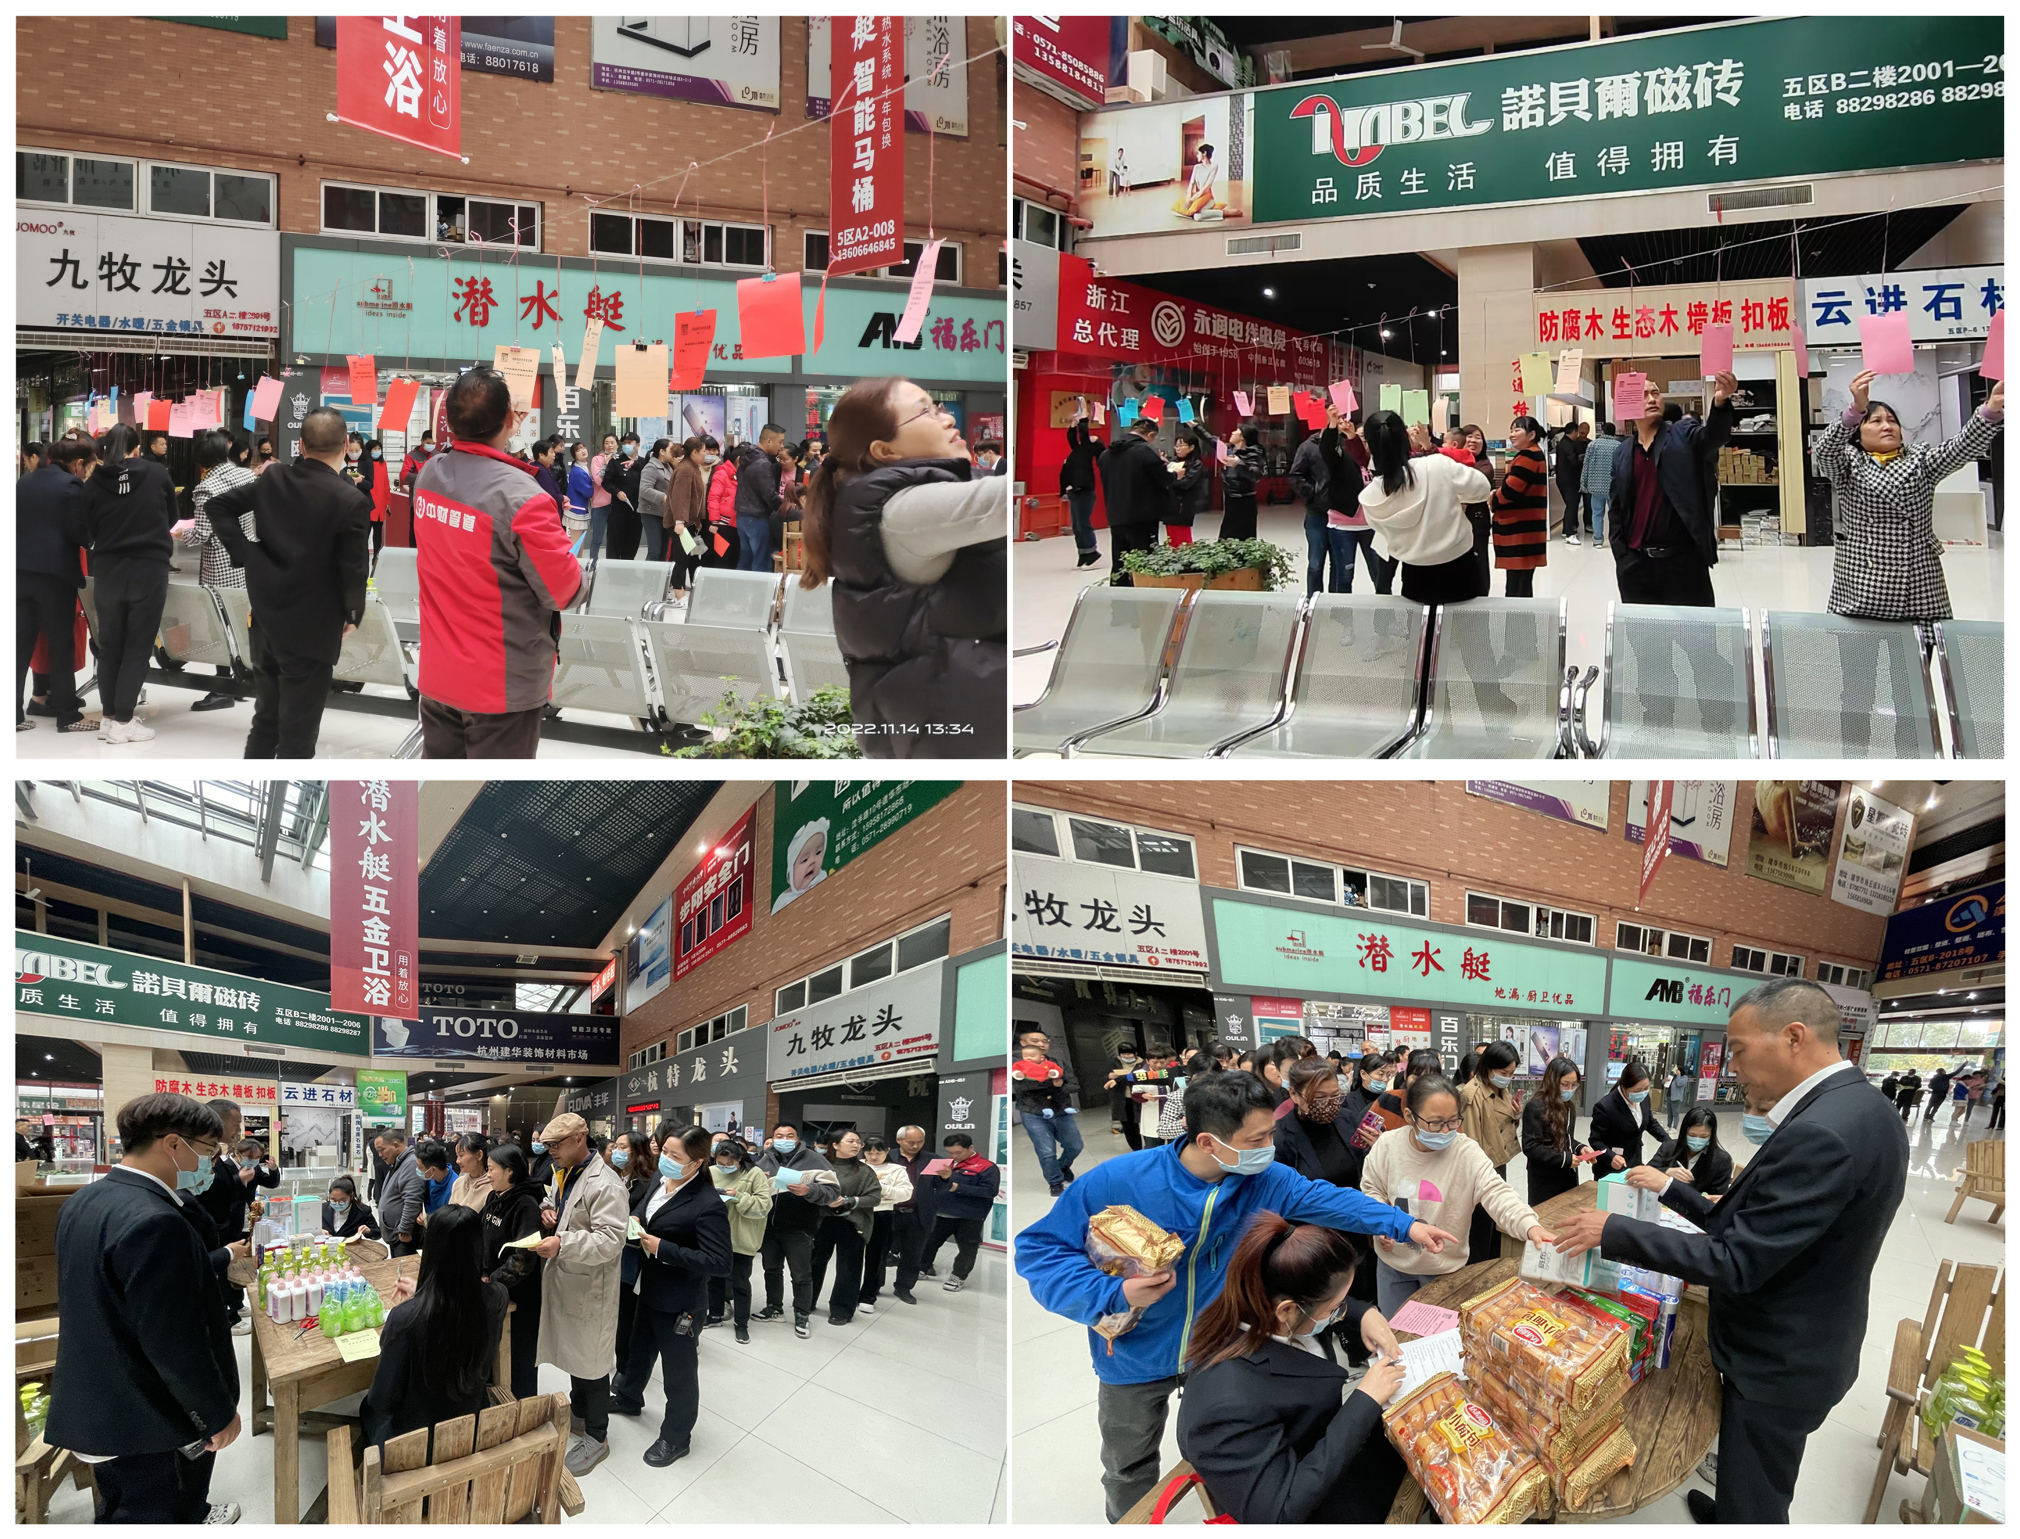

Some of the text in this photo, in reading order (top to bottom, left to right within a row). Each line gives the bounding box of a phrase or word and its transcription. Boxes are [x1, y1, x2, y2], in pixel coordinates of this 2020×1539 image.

[464, 39, 539, 59] www.faenza.com.cn
[738, 16, 760, 56] 房
[1034, 46, 1105, 95] 13588184811
[1784, 99, 1825, 121] 电话
[1835, 88, 1937, 115] 88298286
[1544, 133, 1741, 182] 值得拥有
[1311, 161, 1478, 205] 品质生活
[837, 219, 896, 248] 5区A2-008
[837, 237, 896, 262] 13606646845
[46, 248, 238, 299] 九牧龙头
[452, 275, 627, 332] 潜水艇
[1086, 283, 1131, 316] 浙江
[930, 316, 1005, 355] 福乐门
[1072, 318, 1141, 351] 总代理
[1538, 296, 1791, 344] 防腐木 生态木 墙板 扣板
[1192, 341, 1239, 361] 始创于1958
[426, 502, 476, 533] 中财管道
[679, 840, 750, 923] 步阳安全门
[1012, 889, 1167, 938] 牧龙头
[1356, 932, 1492, 982] 潜水艇
[397, 954, 409, 1005] 用着放心
[423, 982, 466, 996] TOTO
[1687, 983, 1732, 1008] 福乐门
[18, 986, 116, 1016] 质生活
[158, 1007, 259, 1036] 值得拥有
[274, 1016, 362, 1038] 电话 88298286 88298287
[433, 1015, 519, 1040] TOTO
[785, 1003, 903, 1058] 九牧龙头
[476, 1045, 589, 1061] 杭州建华装饰材料市场
[1440, 1016, 1459, 1071] 百乐门
[646, 1046, 739, 1093] 杭特龙头
[155, 1078, 277, 1101] 防腐木 生态木 墙板 扣板
[283, 1086, 354, 1104] 云进石材
